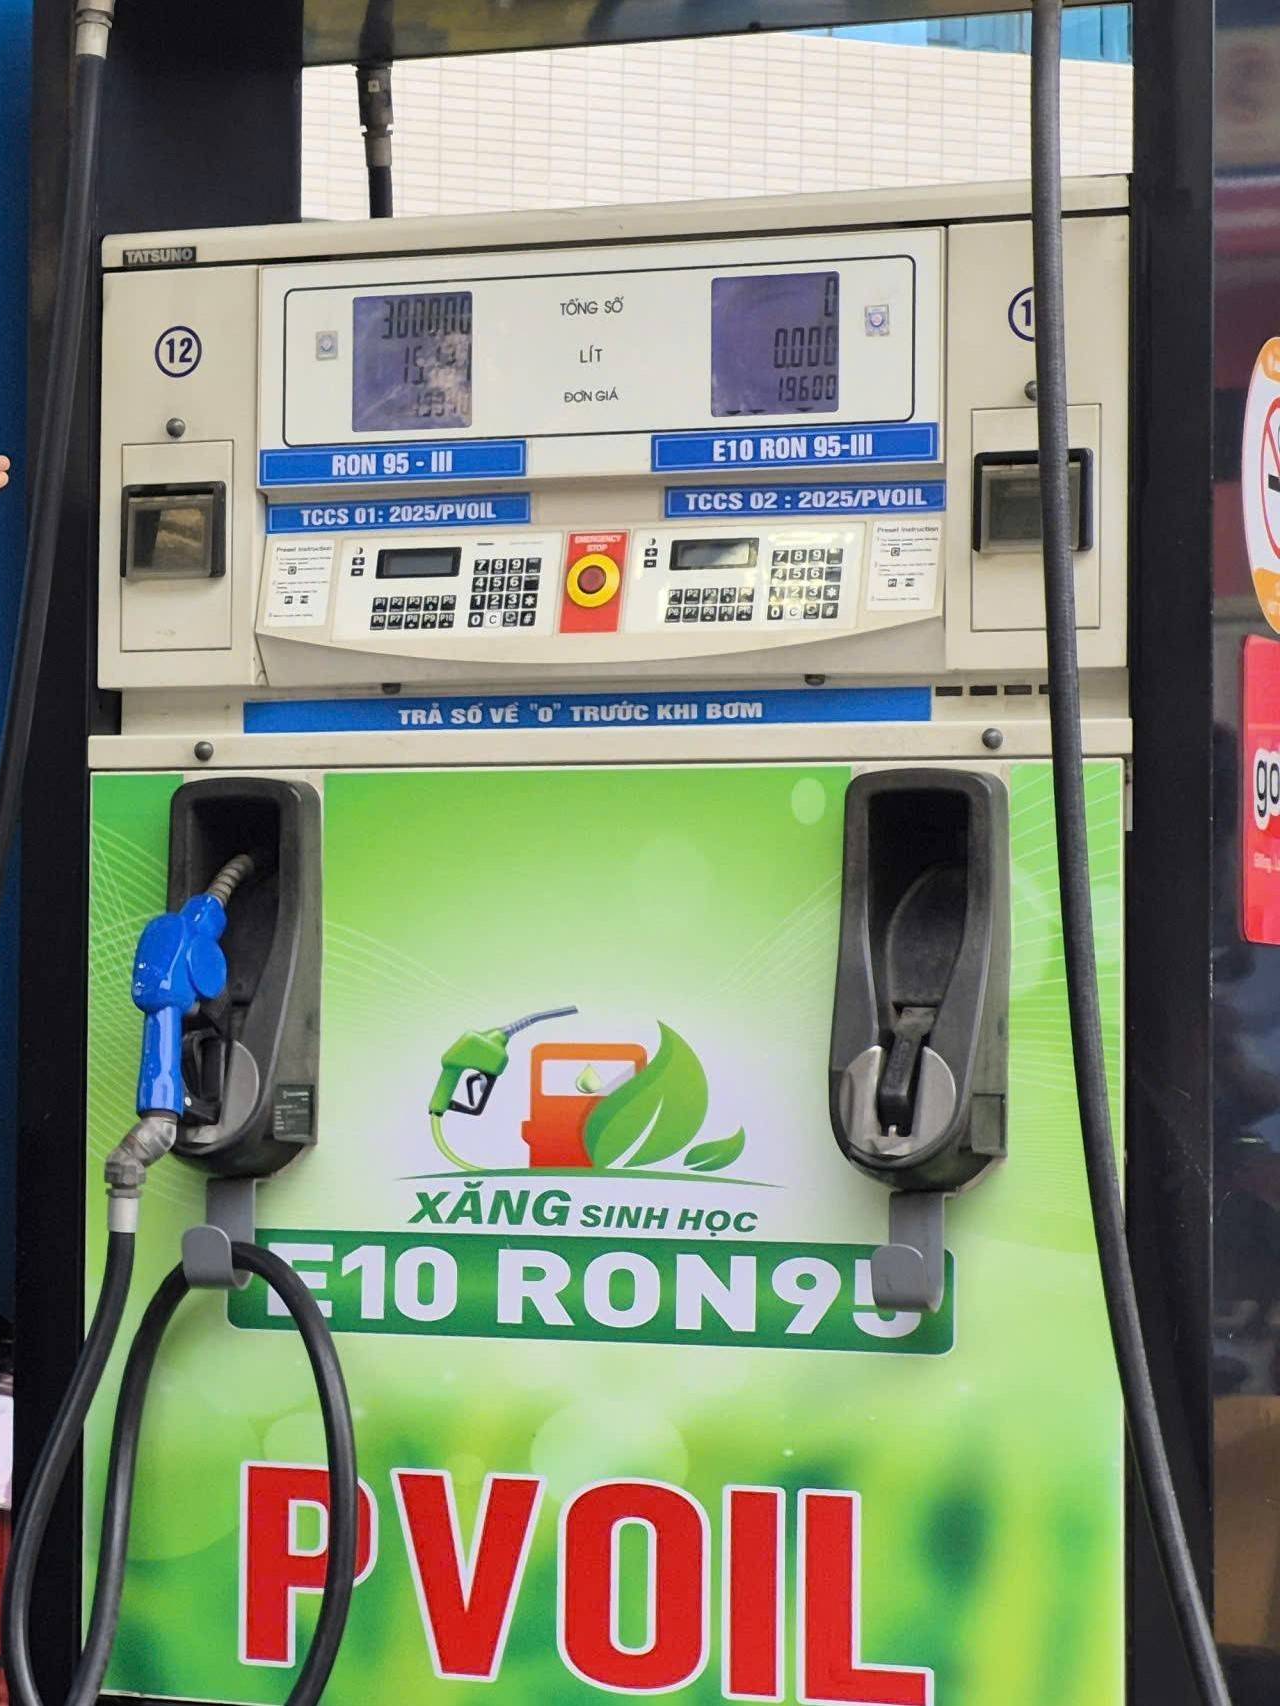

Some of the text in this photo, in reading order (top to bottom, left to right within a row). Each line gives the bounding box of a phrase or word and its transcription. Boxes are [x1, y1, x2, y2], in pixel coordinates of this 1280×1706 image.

[125, 247, 193, 264] TATSUNO
[604, 296, 624, 314] SỐ
[165, 337, 193, 363] 12
[579, 344, 603, 363] LÍT
[564, 386, 619, 403] ĐƠN GIÁ
[712, 433, 873, 462] E10 RON 95-III
[332, 453, 377, 476] RON
[383, 452, 410, 475] 95
[431, 450, 453, 473] III
[686, 492, 743, 511] TCCS
[749, 491, 779, 510] 02
[798, 488, 928, 508] 2025/PVOIL
[300, 502, 497, 526] TCCS 01: 2025/PVOIL
[477, 560, 486, 570] 7
[494, 559, 504, 570] 8
[511, 559, 521, 569] 9
[475, 576, 519, 587] 4 5 6
[474, 594, 517, 606] 1 2 3
[471, 614, 481, 626] 0
[397, 702, 444, 725] TRẢ
[450, 702, 484, 724] SỐ
[489, 701, 520, 723] VỀ
[570, 701, 649, 722] TRƯỚC
[657, 703, 698, 721] KHI
[706, 701, 763, 719] BƠM
[407, 1180, 759, 1237] XĂNG SINH HỌC
[266, 1242, 458, 1322] E10
[241, 1463, 931, 1706] PVOIL
